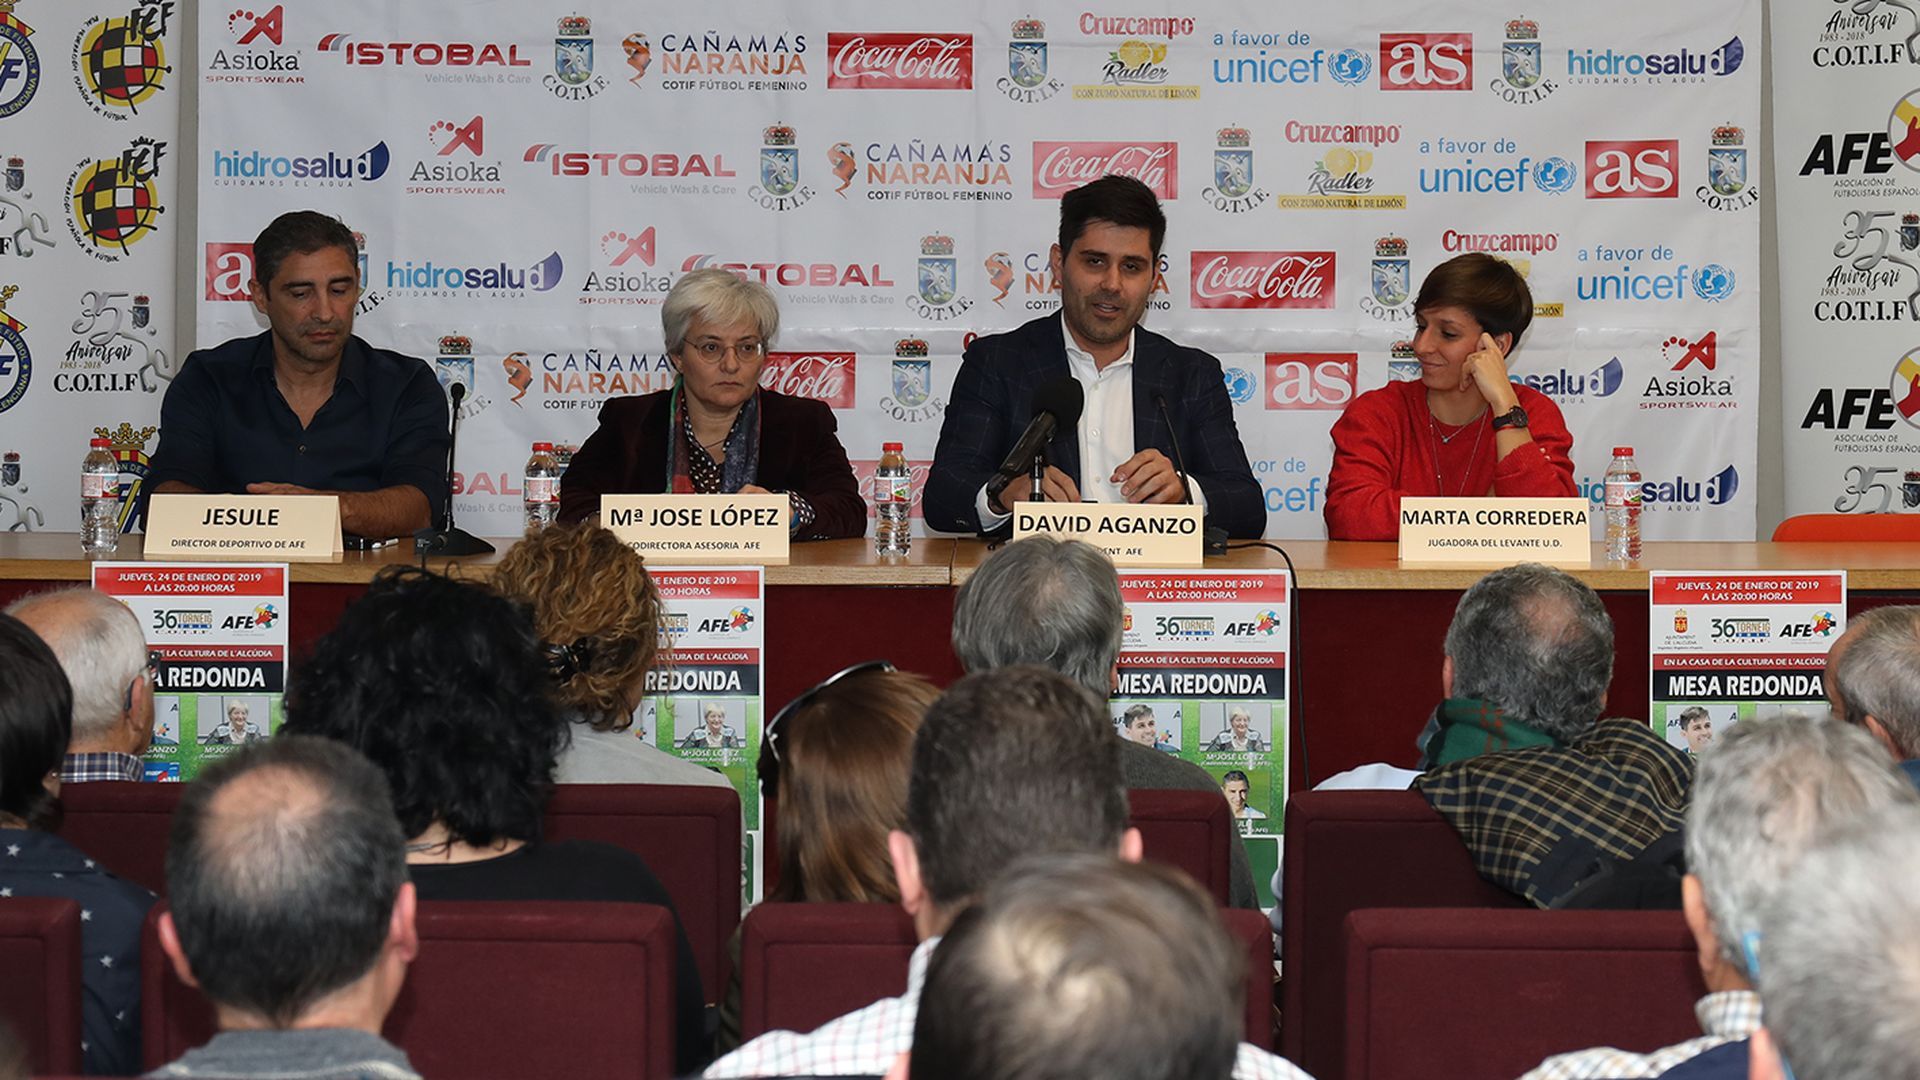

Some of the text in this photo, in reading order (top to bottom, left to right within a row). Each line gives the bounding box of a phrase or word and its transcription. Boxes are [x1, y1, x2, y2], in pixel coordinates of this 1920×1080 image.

[1079, 12, 1194, 39] Cruzcampo
[1826, 10, 1899, 34] Aniversari
[661, 30, 807, 53] CAÑAMÁS
[1213, 31, 1310, 46] a favor de
[208, 50, 300, 71] Asioka
[346, 42, 531, 66] ISTOBAL
[661, 53, 808, 75] NARANJA
[833, 37, 968, 80] Coca-Cola
[1387, 41, 1468, 86] as
[1568, 48, 1727, 76] hidrosalud
[1101, 60, 1169, 85] Radler
[1213, 50, 1323, 84] unicef
[205, 76, 305, 84] SPORTSWEAR
[424, 74, 532, 84] Vehicle Wash Care
[662, 79, 808, 91] COTIF FÚTBOL FEMENINO
[1284, 120, 1400, 147] Cruzcampo
[866, 140, 1011, 162] CAÑAMÁS
[1419, 138, 1516, 154] a favor de
[1799, 133, 1895, 176] AFE
[214, 150, 372, 181] hidrosalud
[409, 161, 502, 182] Asioka
[552, 153, 736, 177] ISTOBAL
[867, 163, 1012, 185] NARANJA
[1592, 149, 1674, 194] as
[1307, 171, 1375, 196] Radler
[1419, 158, 1530, 193] unicef
[405, 187, 506, 195] SPORTSWEAR
[631, 185, 737, 195] Vehicle Wash Care
[867, 189, 1012, 200] COTIF FÚTBOL FEMENINO
[1325, 199, 1361, 208] NATURAL
[1376, 198, 1403, 208] LIMÓN
[1442, 229, 1558, 255] Cruzcampo
[1577, 245, 1673, 261] a favor de
[387, 262, 544, 290] hidrosalud
[582, 271, 671, 292] Asioka
[710, 263, 894, 286] STOBAL
[1197, 255, 1331, 299] Coca-Cola
[1577, 265, 1688, 300] unicef
[1827, 265, 1900, 291] Aniversari
[66, 340, 133, 364] Aniversari
[1273, 361, 1353, 404] as
[1643, 376, 1733, 397] Asioka
[543, 400, 577, 409] COTIF
[1800, 388, 1897, 429] AFE
[1284, 457, 1306, 472] de
[202, 508, 280, 526] JESULE
[650, 508, 703, 527] JOSE
[711, 504, 778, 527] LÓPEZ
[1019, 515, 1196, 534] DAVID AGANZO
[1402, 510, 1587, 526] MARTA CORREDERA
[171, 539, 305, 549] DIRECTOR DEPORTIVO DE AFE
[694, 541, 739, 550] ASESORIA
[743, 541, 760, 550] AFE
[1126, 547, 1143, 556] AFE
[1428, 539, 1562, 547] JUGADORA DEL LEVANTE U.D.
[118, 573, 262, 582] JUEVES, 24 DE ENERO DE 2019
[1121, 580, 1263, 589] JUEVES, 24 DE ENERO DE 2019
[1675, 581, 1819, 591] JUEVES, 24 DE ENERO DE 2019
[154, 584, 236, 593] LAS 20:00 HORAS
[1156, 591, 1237, 599] LAS 20:00 HORAS
[1712, 592, 1793, 601] LAS 20:00 HORAS
[153, 610, 178, 629] 36
[221, 615, 254, 630] AFE
[697, 618, 730, 632] AFE
[1156, 616, 1180, 636] 36
[1223, 622, 1256, 636] AFE
[1711, 618, 1735, 638] 36
[1780, 624, 1812, 638] AFE
[178, 650, 216, 658] CULTURA
[1133, 656, 1155, 664] CASA
[1181, 656, 1218, 664] CULTURA
[1663, 658, 1787, 666] EN LA CASA DE LA CULTURA DE
[168, 667, 265, 687] REDONDA
[644, 670, 741, 691] REDONDA
[1113, 674, 1267, 694] MESA REDONDA
[1668, 675, 1824, 696] MESA REDONDA
